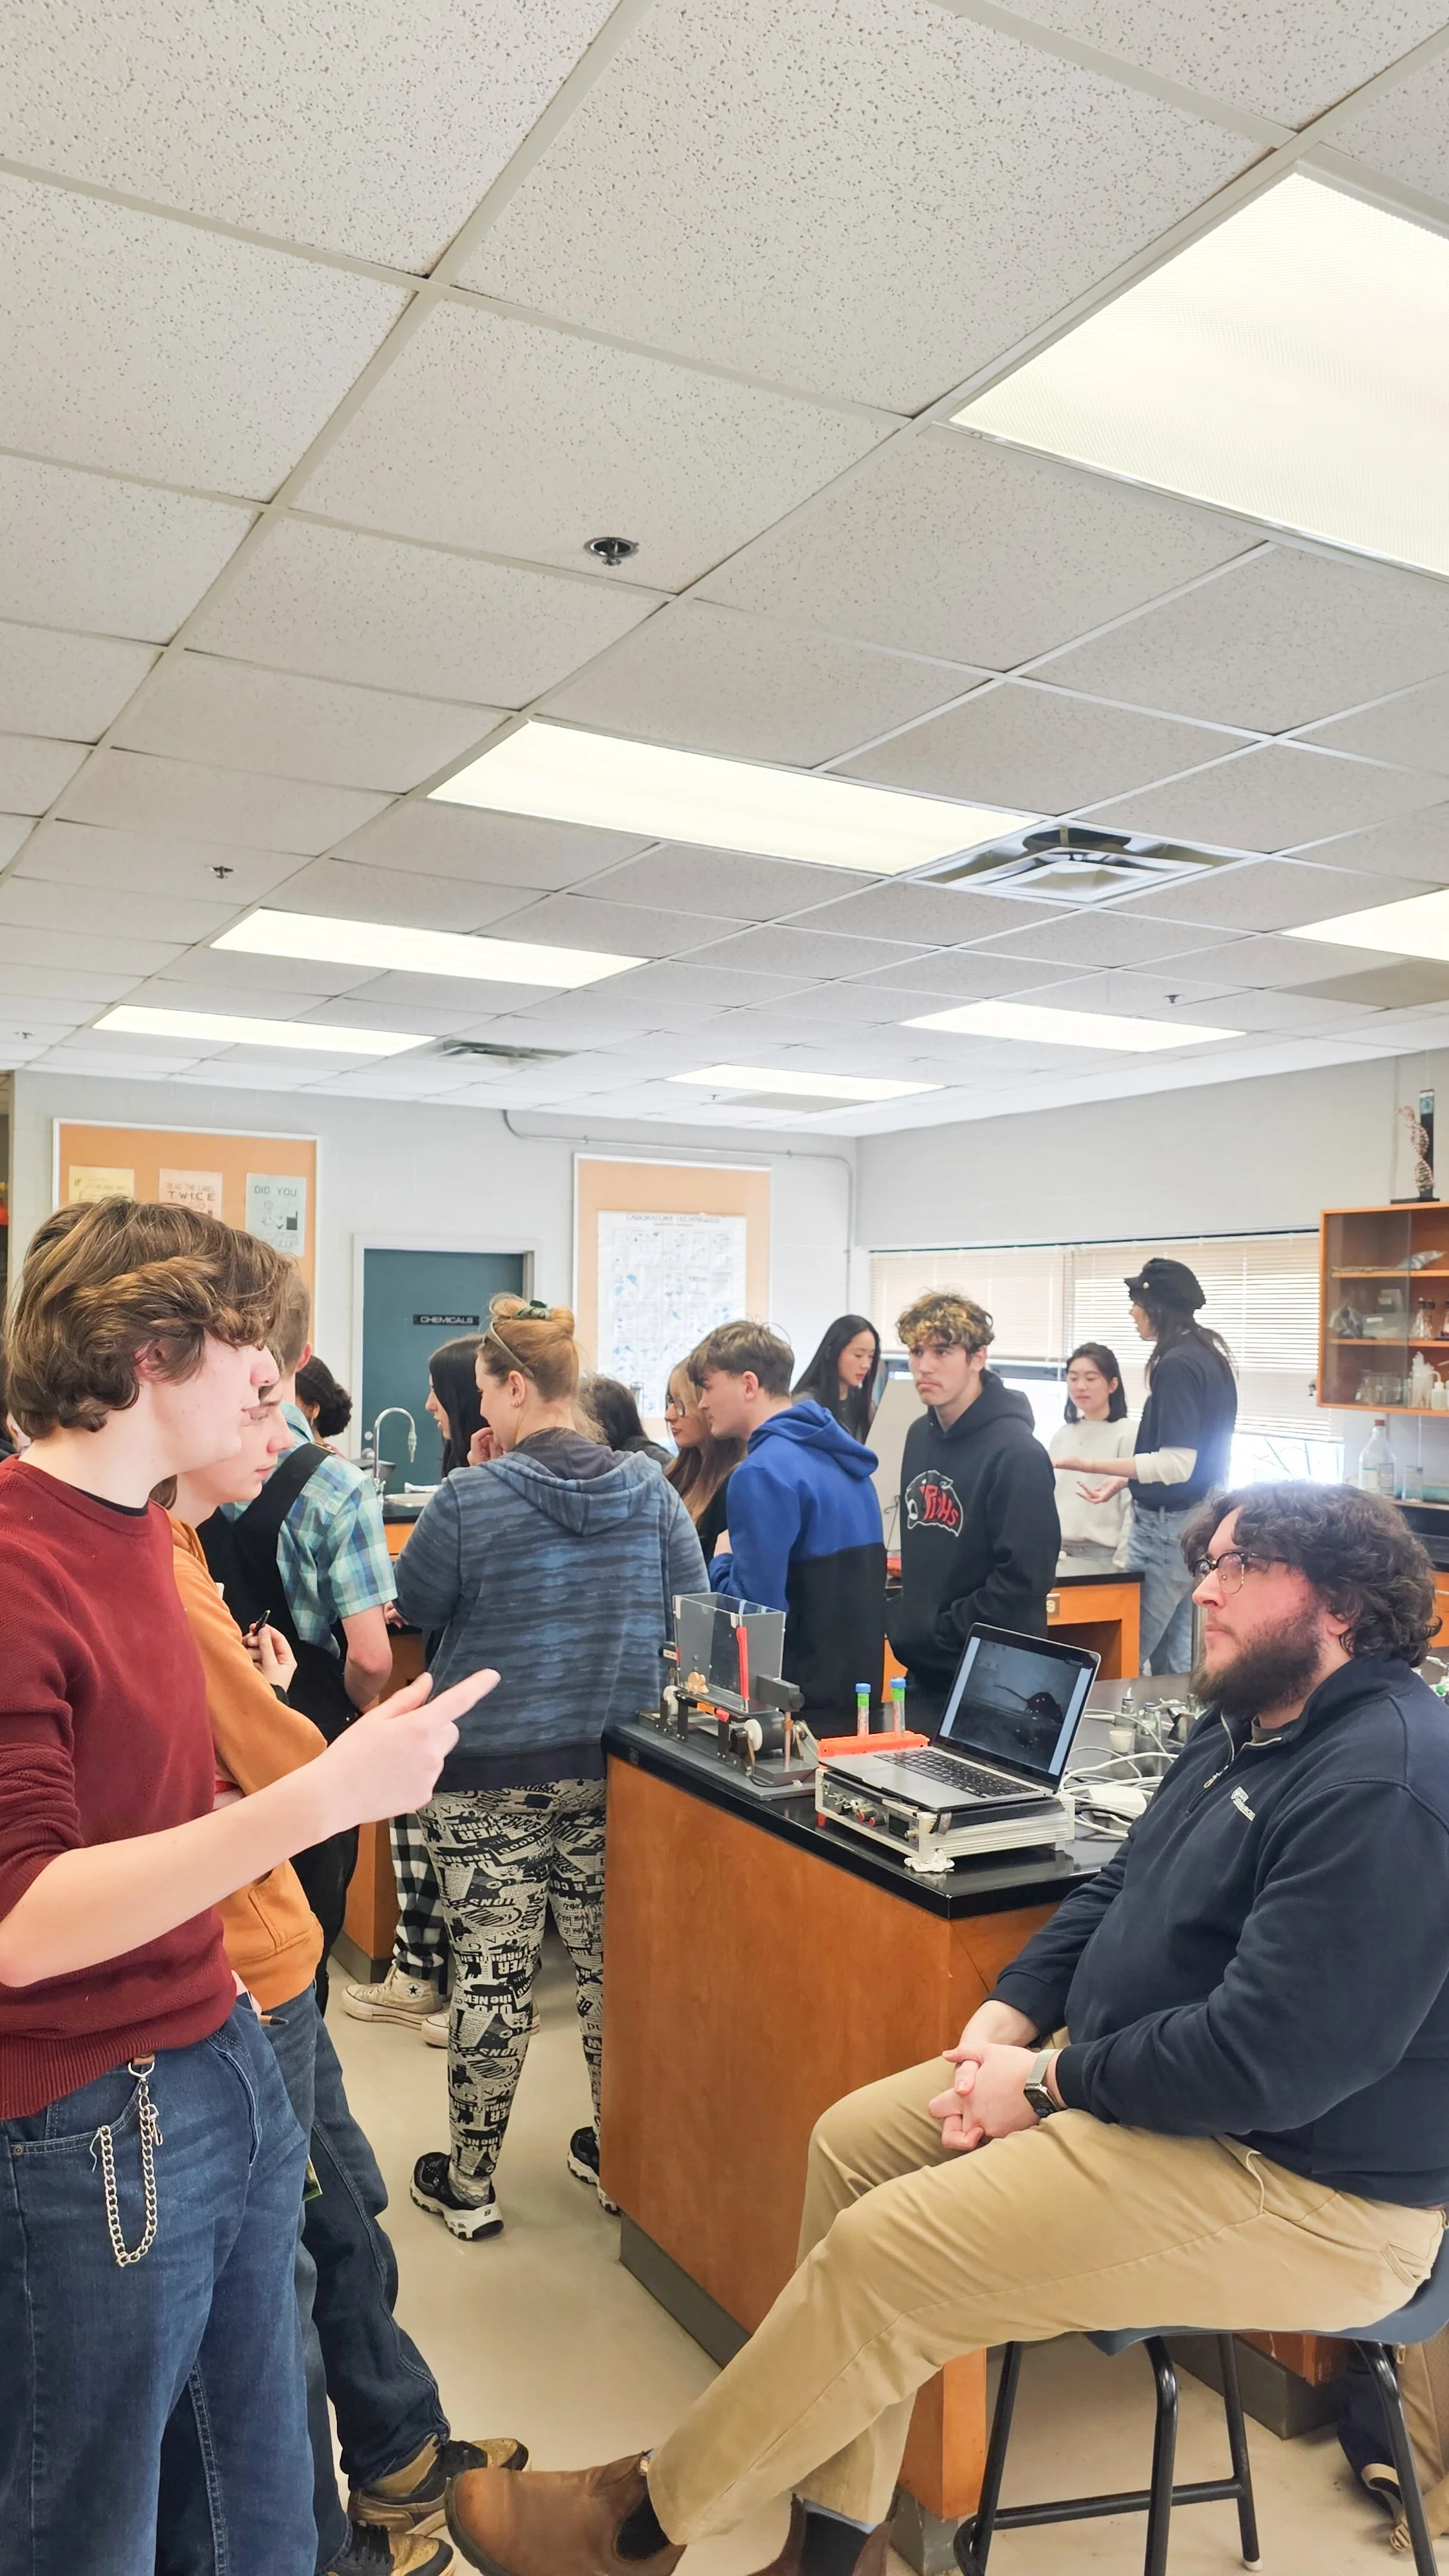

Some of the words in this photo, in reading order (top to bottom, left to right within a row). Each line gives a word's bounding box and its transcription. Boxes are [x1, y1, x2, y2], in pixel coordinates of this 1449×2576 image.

[168, 1190, 216, 1201] TWICE
[254, 1185, 271, 1194] DID
[276, 1187, 297, 1197] YOU
